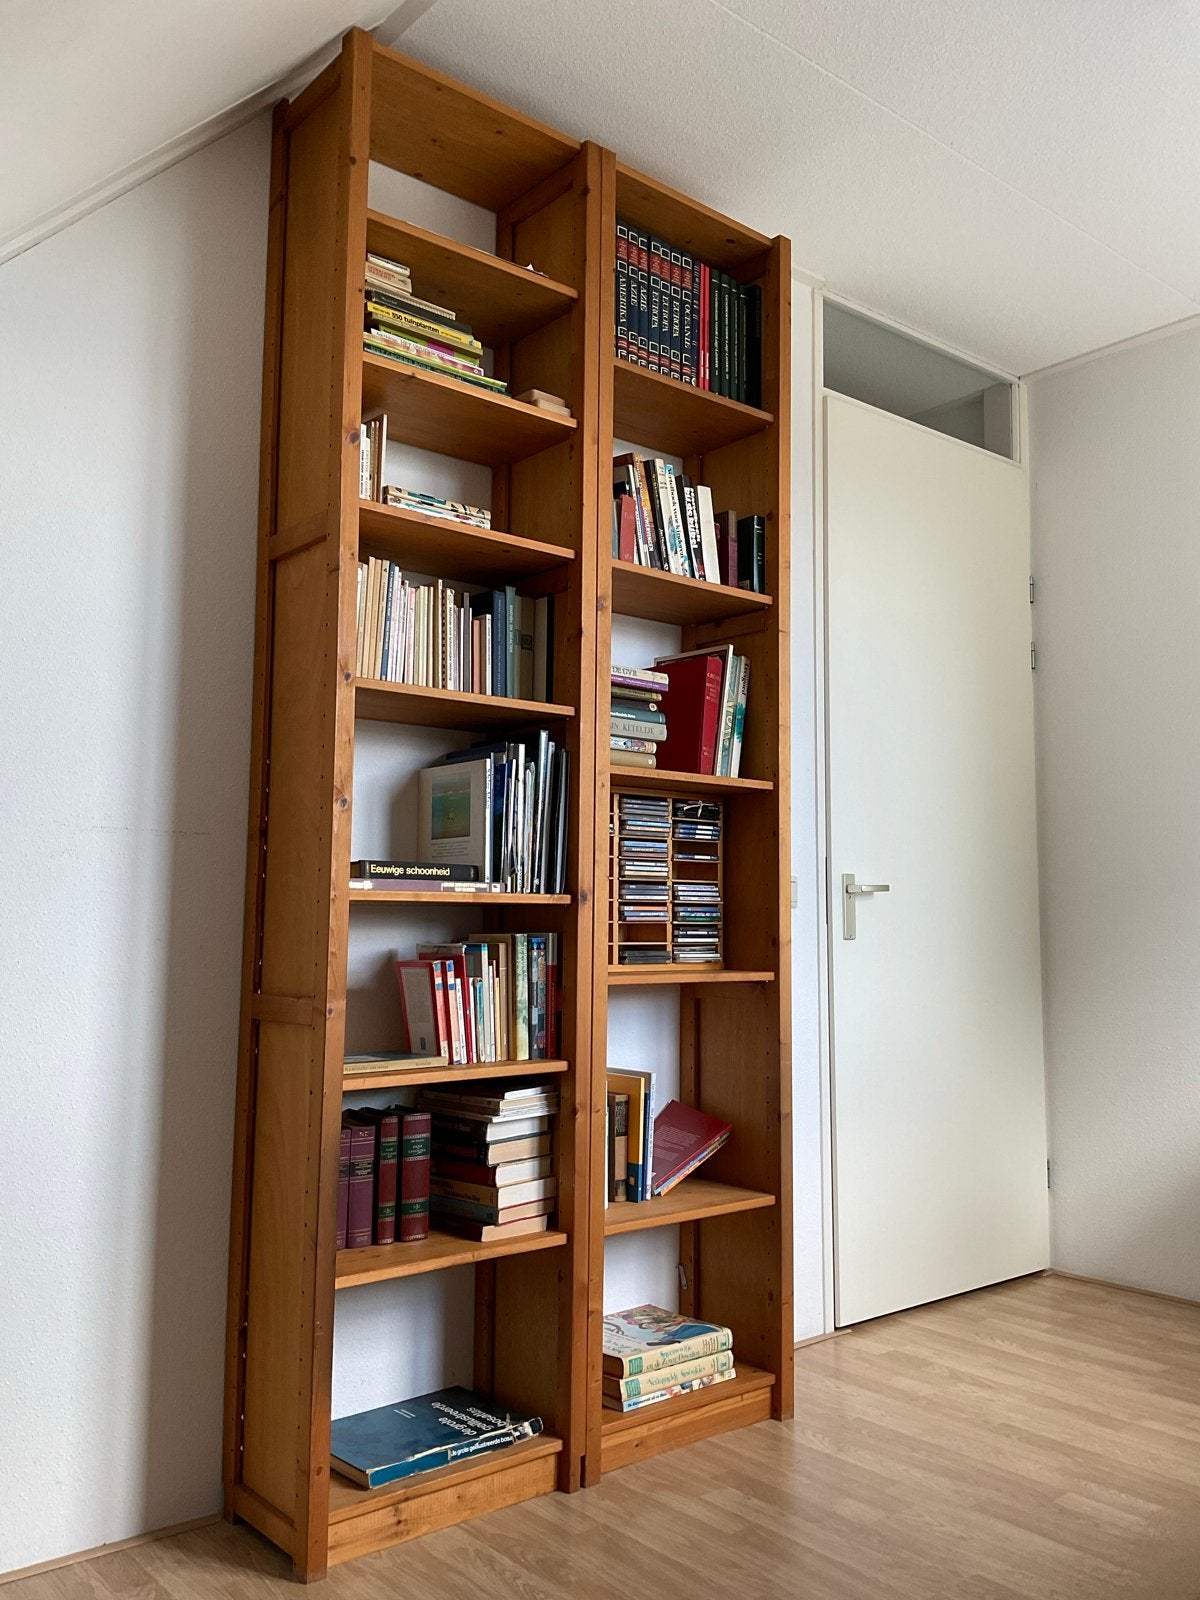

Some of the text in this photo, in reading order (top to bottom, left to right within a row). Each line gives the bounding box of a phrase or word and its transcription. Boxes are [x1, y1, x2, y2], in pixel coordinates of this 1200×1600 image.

[619, 274, 628, 323] AMERIKA
[651, 291, 659, 328] EUROPA
[672, 301, 680, 338] EUROPA
[403, 316, 440, 334] tuinplanten
[370, 864, 451, 876] Eeuwige schoonheid
[438, 1416, 468, 1431] grote
[466, 1406, 507, 1427] bosatlas
